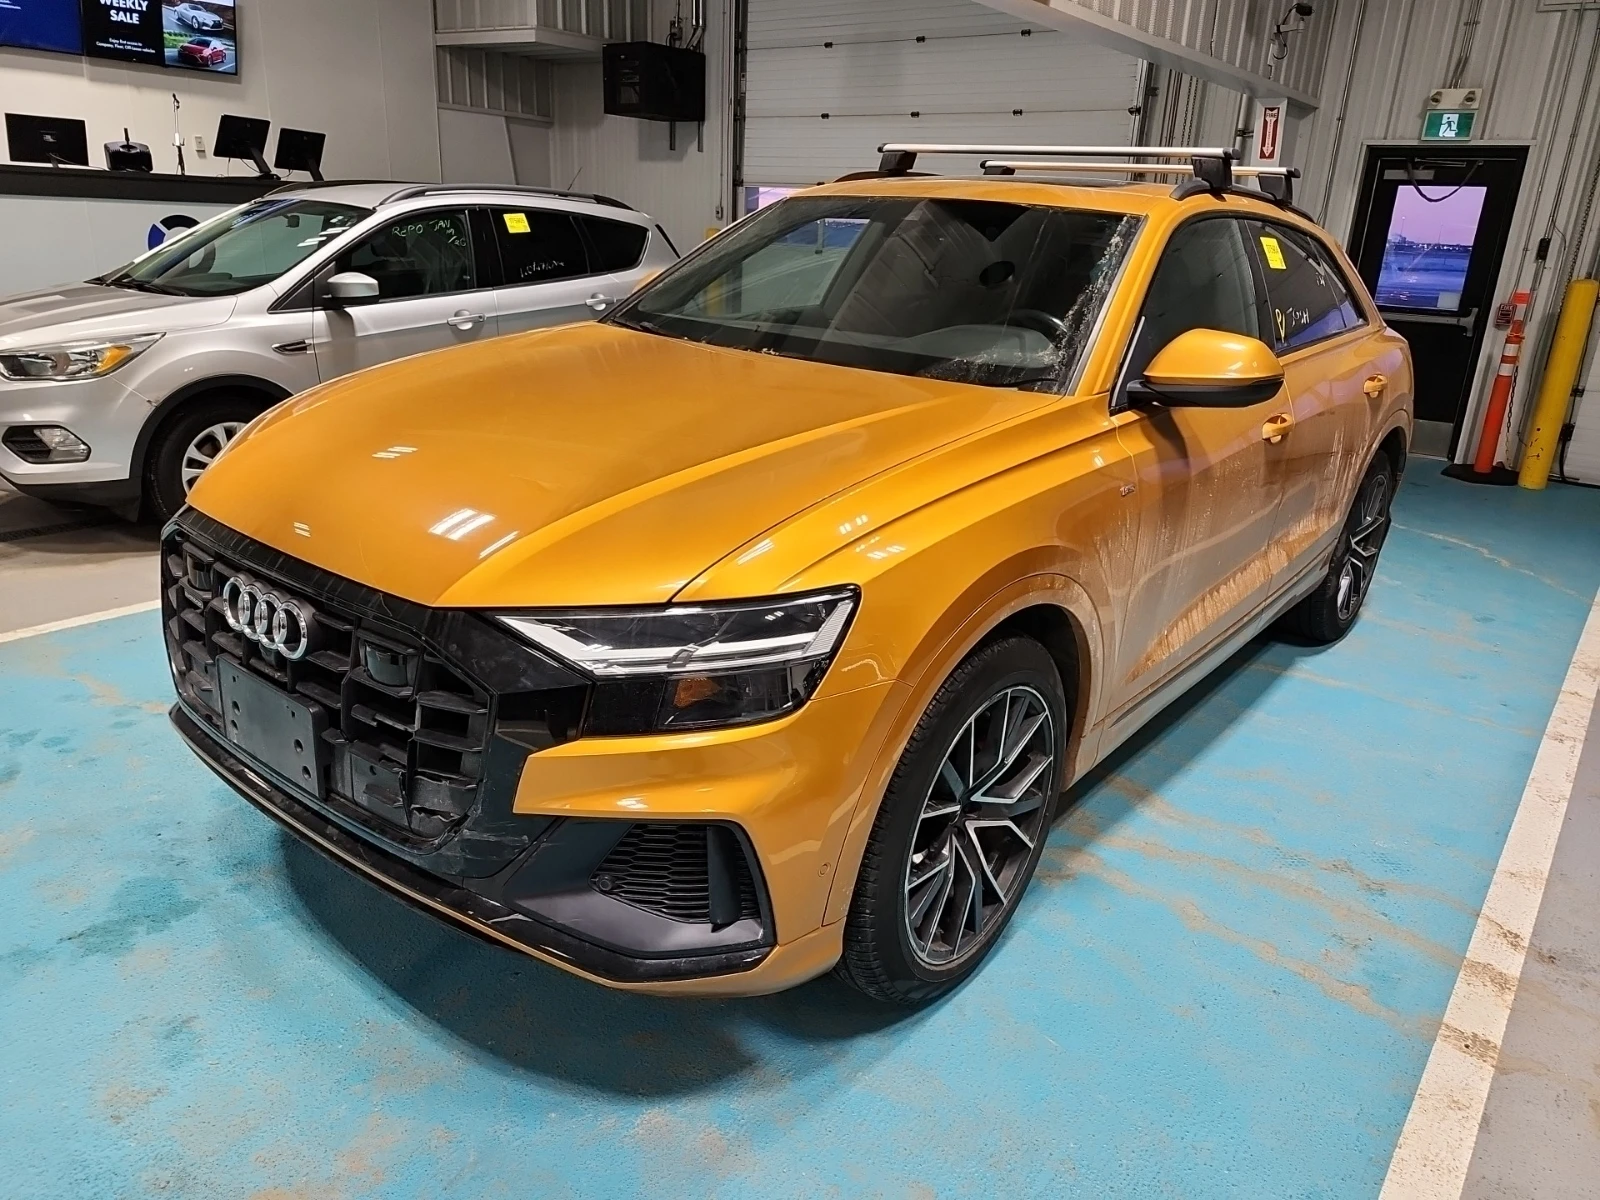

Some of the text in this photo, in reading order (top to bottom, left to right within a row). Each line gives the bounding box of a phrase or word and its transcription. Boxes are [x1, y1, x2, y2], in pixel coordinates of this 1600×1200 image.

[110, 9, 140, 24] SALE
[392, 219, 451, 237] REPO JAN
